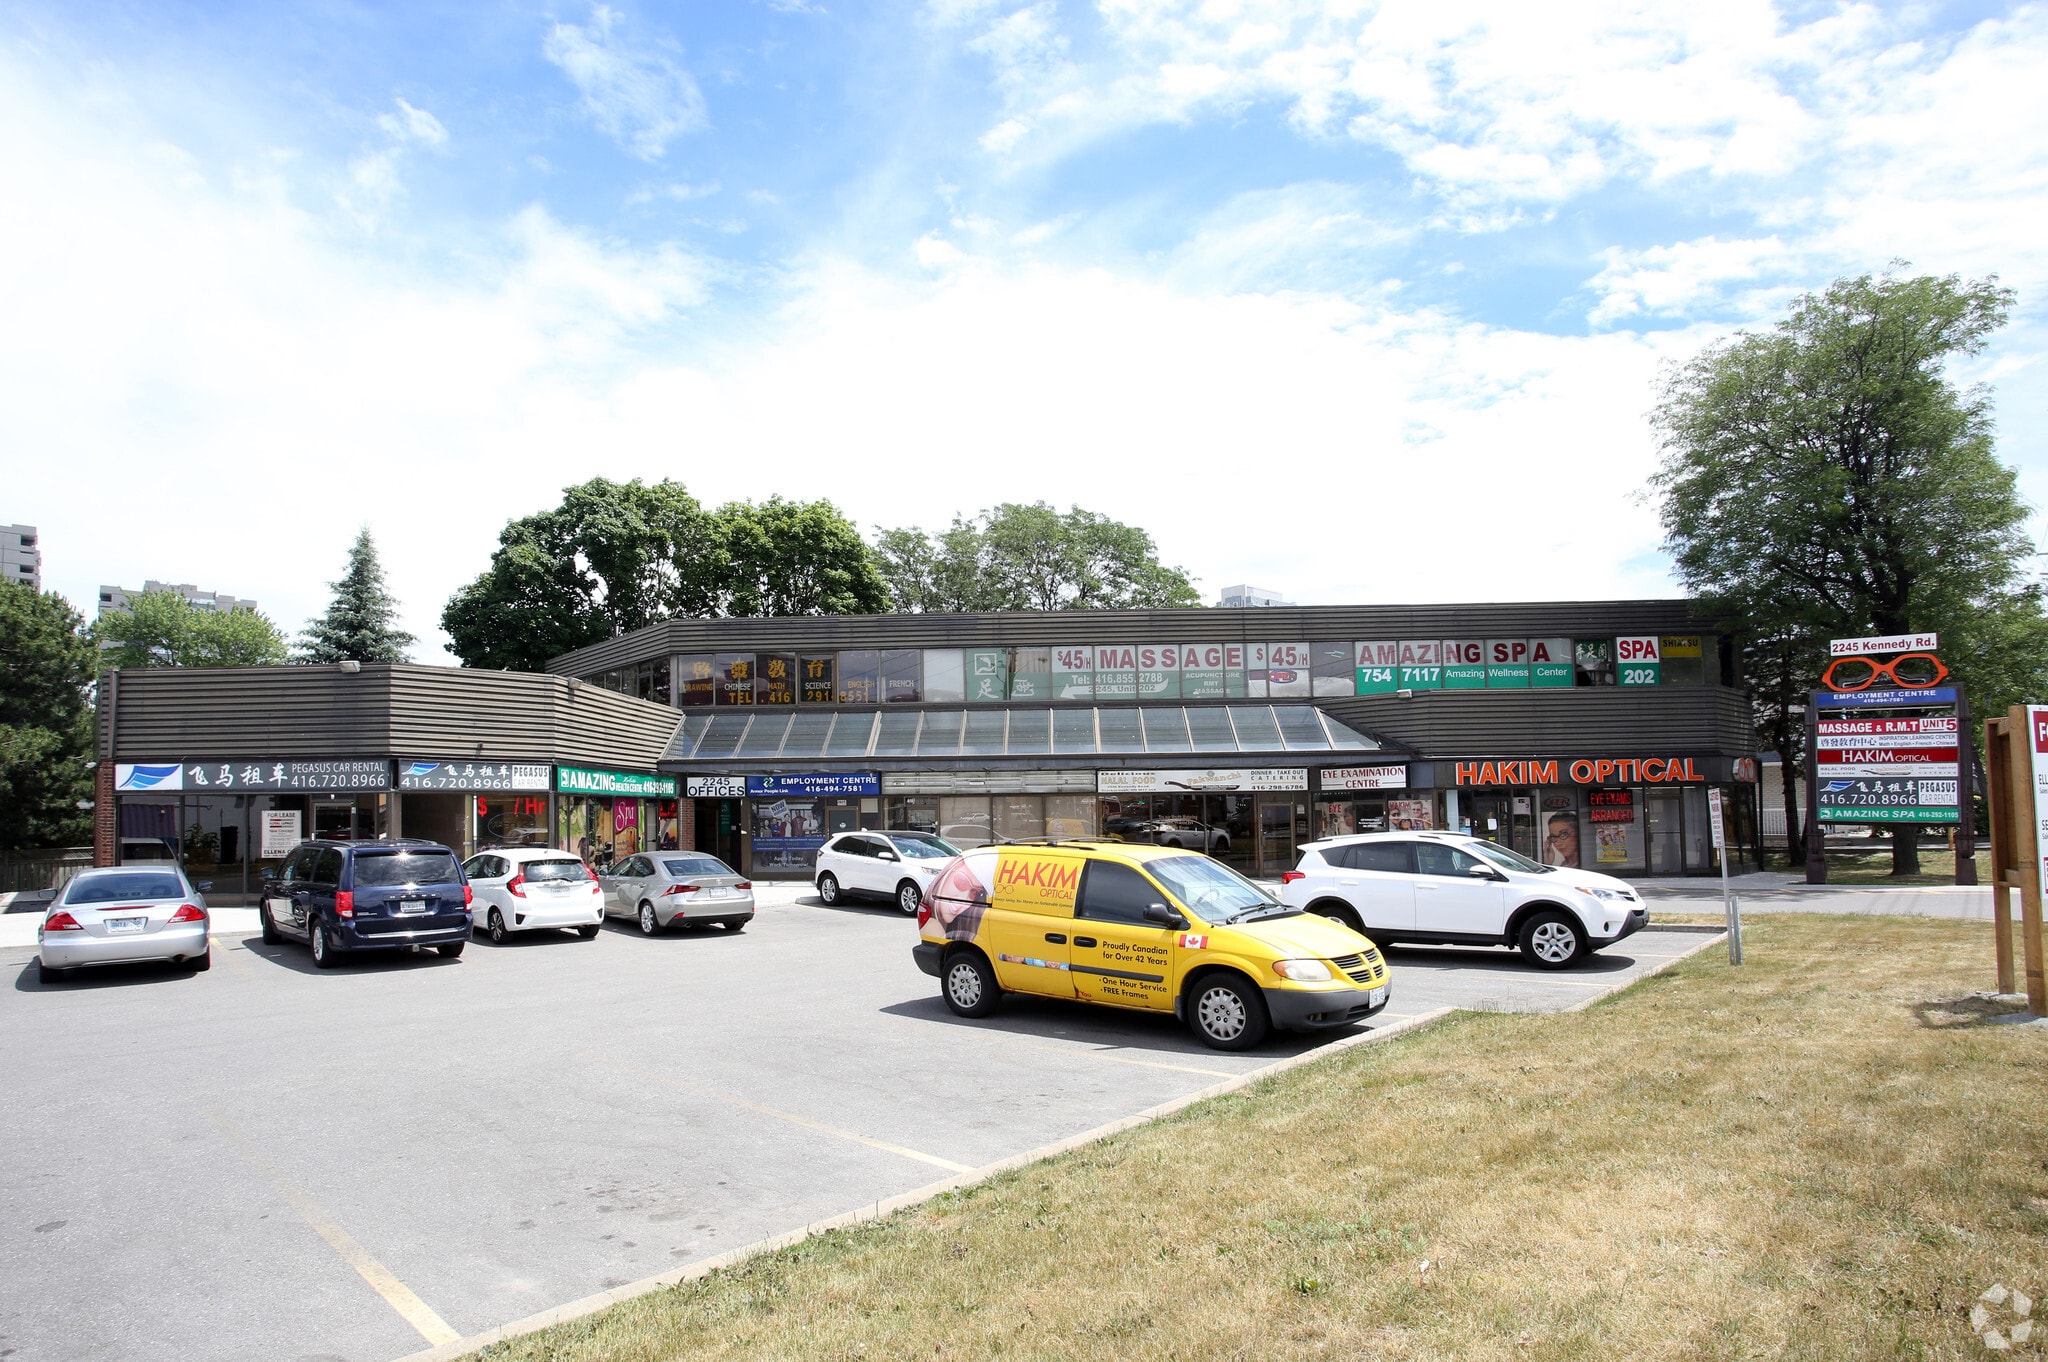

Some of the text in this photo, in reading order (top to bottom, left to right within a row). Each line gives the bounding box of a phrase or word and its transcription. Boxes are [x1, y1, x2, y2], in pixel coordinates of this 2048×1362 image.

[1619, 640, 1658, 659] SPA
[1832, 637, 1935, 653] 2245 Kennedy Rd.
[1100, 648, 1242, 669] MASSAGE
[1358, 642, 1550, 665] AMAZING SPA
[1071, 672, 1163, 685] Tel: 416.855.2788
[1362, 668, 1440, 683] 754 7117
[1446, 667, 1567, 680] Amazing Wellness Center
[1624, 669, 1655, 684] 202
[683, 683, 713, 691] DRAWING
[724, 683, 751, 691] CHINESE
[768, 682, 785, 690] MATH
[805, 681, 832, 690] SCIENCE
[847, 680, 875, 688] ENGLISH
[889, 680, 914, 688] FRENCH
[1117, 684, 1136, 692] Unit
[1139, 683, 1156, 691] 202
[769, 692, 790, 703] 416
[1833, 691, 1894, 699] EMPLOYMENT
[1819, 722, 1873, 733] MASSAGE
[1885, 721, 1918, 732] R.M.T
[1922, 719, 1946, 728] UNIT
[1946, 719, 1957, 730] 5
[2039, 722, 2048, 742] F
[1842, 750, 1894, 762] HAKIM
[291, 762, 385, 774] PEGASUS CAR RENTAL
[444, 763, 510, 778] 飞马租车
[513, 765, 549, 778] PEGASUS
[1322, 767, 1404, 779] EYE EXAMINATION
[1456, 757, 1704, 785] HAKIM OPTICAL
[188, 762, 288, 788] 飞马租车
[291, 774, 385, 788] 416.720.8966
[570, 769, 616, 791] AMAZING
[781, 776, 877, 785] EMPLOYMENT CENTRE
[401, 777, 511, 789] 416.720.8966
[615, 782, 630, 792] HEALTH
[702, 777, 730, 786] 2245
[1345, 779, 1381, 788] CENTRE
[1856, 780, 1917, 793] 飞马租车
[1920, 782, 1956, 792] PEGASUS
[688, 786, 745, 796] OFFICES
[805, 785, 862, 793] 416-494-7581
[1590, 792, 1632, 805] EYE EXAMS
[1820, 794, 1917, 805] 416.720.8966
[1920, 794, 1933, 803] CAR
[1328, 804, 1342, 814] EYE
[1891, 810, 1916, 818] SPA
[615, 801, 634, 831] Spa
[1591, 809, 1633, 822] ARRANGED
[998, 859, 1079, 890] HAKIM
[1039, 888, 1074, 900] OPTICAL
[1102, 940, 1168, 955] Proudly Canadian
[1102, 951, 1168, 966] for Over 42 Years
[1119, 978, 1137, 988] Hour
[1139, 980, 1167, 992] Service
[1121, 987, 1149, 999] Frames
